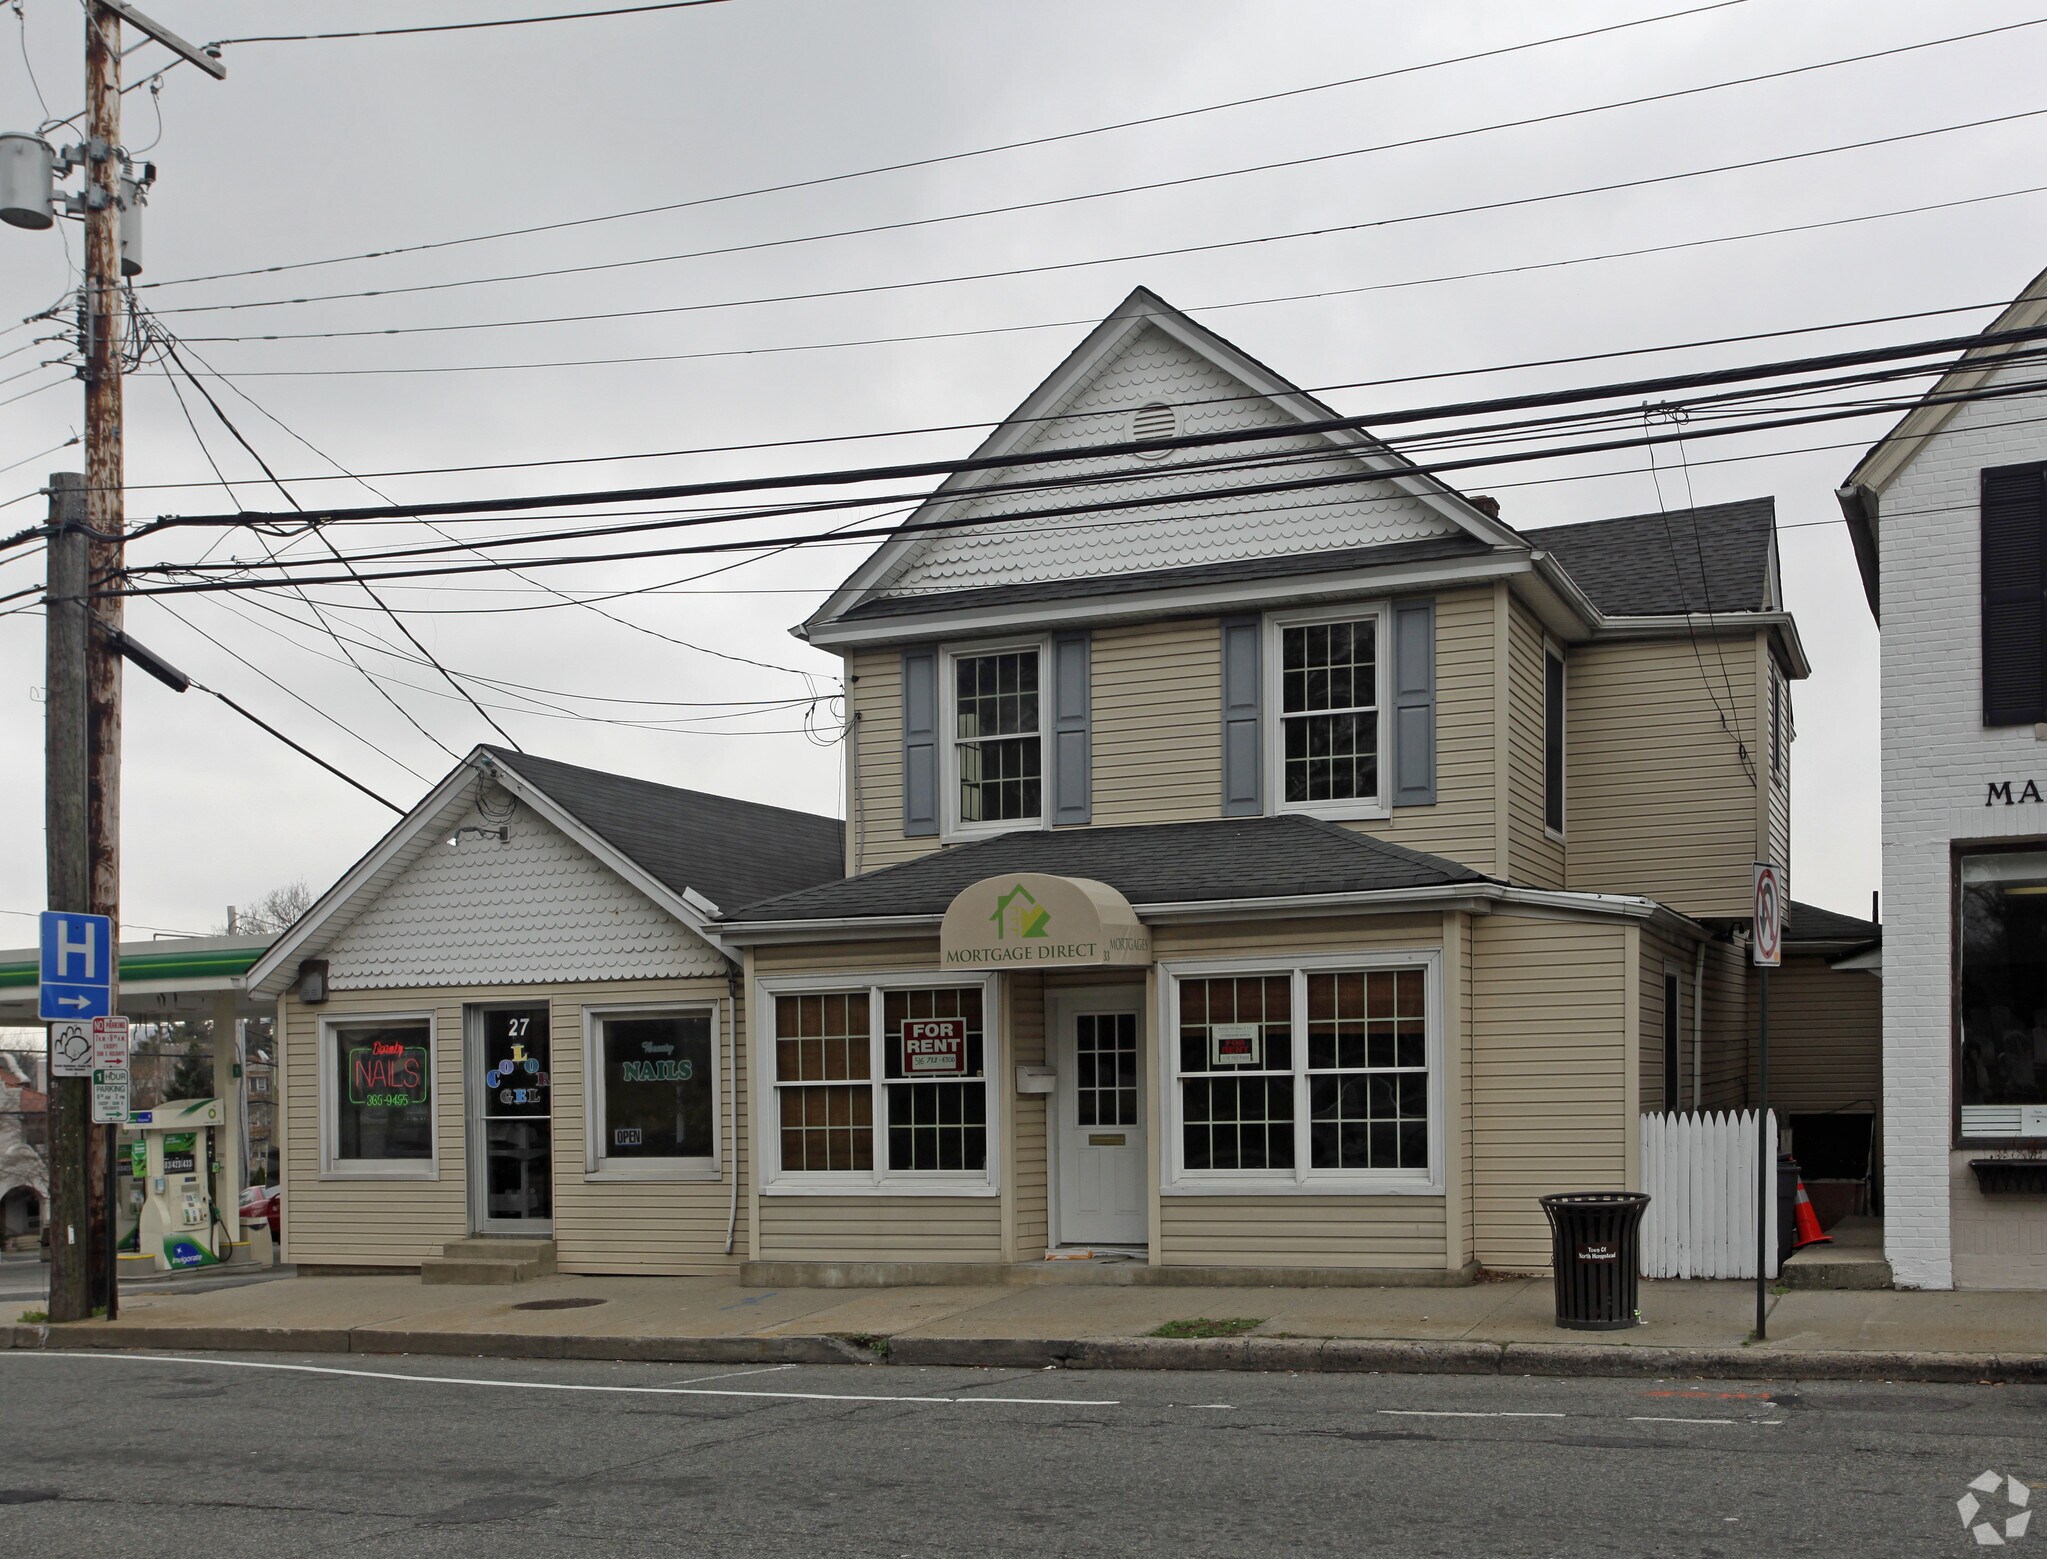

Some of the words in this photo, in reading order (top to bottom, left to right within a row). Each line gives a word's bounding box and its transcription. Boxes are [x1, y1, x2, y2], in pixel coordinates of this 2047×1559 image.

[57, 920, 95, 978] H
[946, 947, 1032, 963] MORTGAGE
[1038, 943, 1097, 959] DIRECT
[1103, 950, 1110, 962] 33
[94, 1020, 104, 1031] NO
[508, 1018, 530, 1037] 27
[913, 1023, 954, 1038] FOR
[907, 1038, 961, 1053] RENT
[97, 1073, 102, 1081] 1
[355, 1058, 420, 1089] NAILS
[622, 1060, 693, 1081] NAILS
[500, 1089, 540, 1104] GEL
[617, 1130, 640, 1144] OPEN
[172, 1255, 202, 1264] Invigorate
